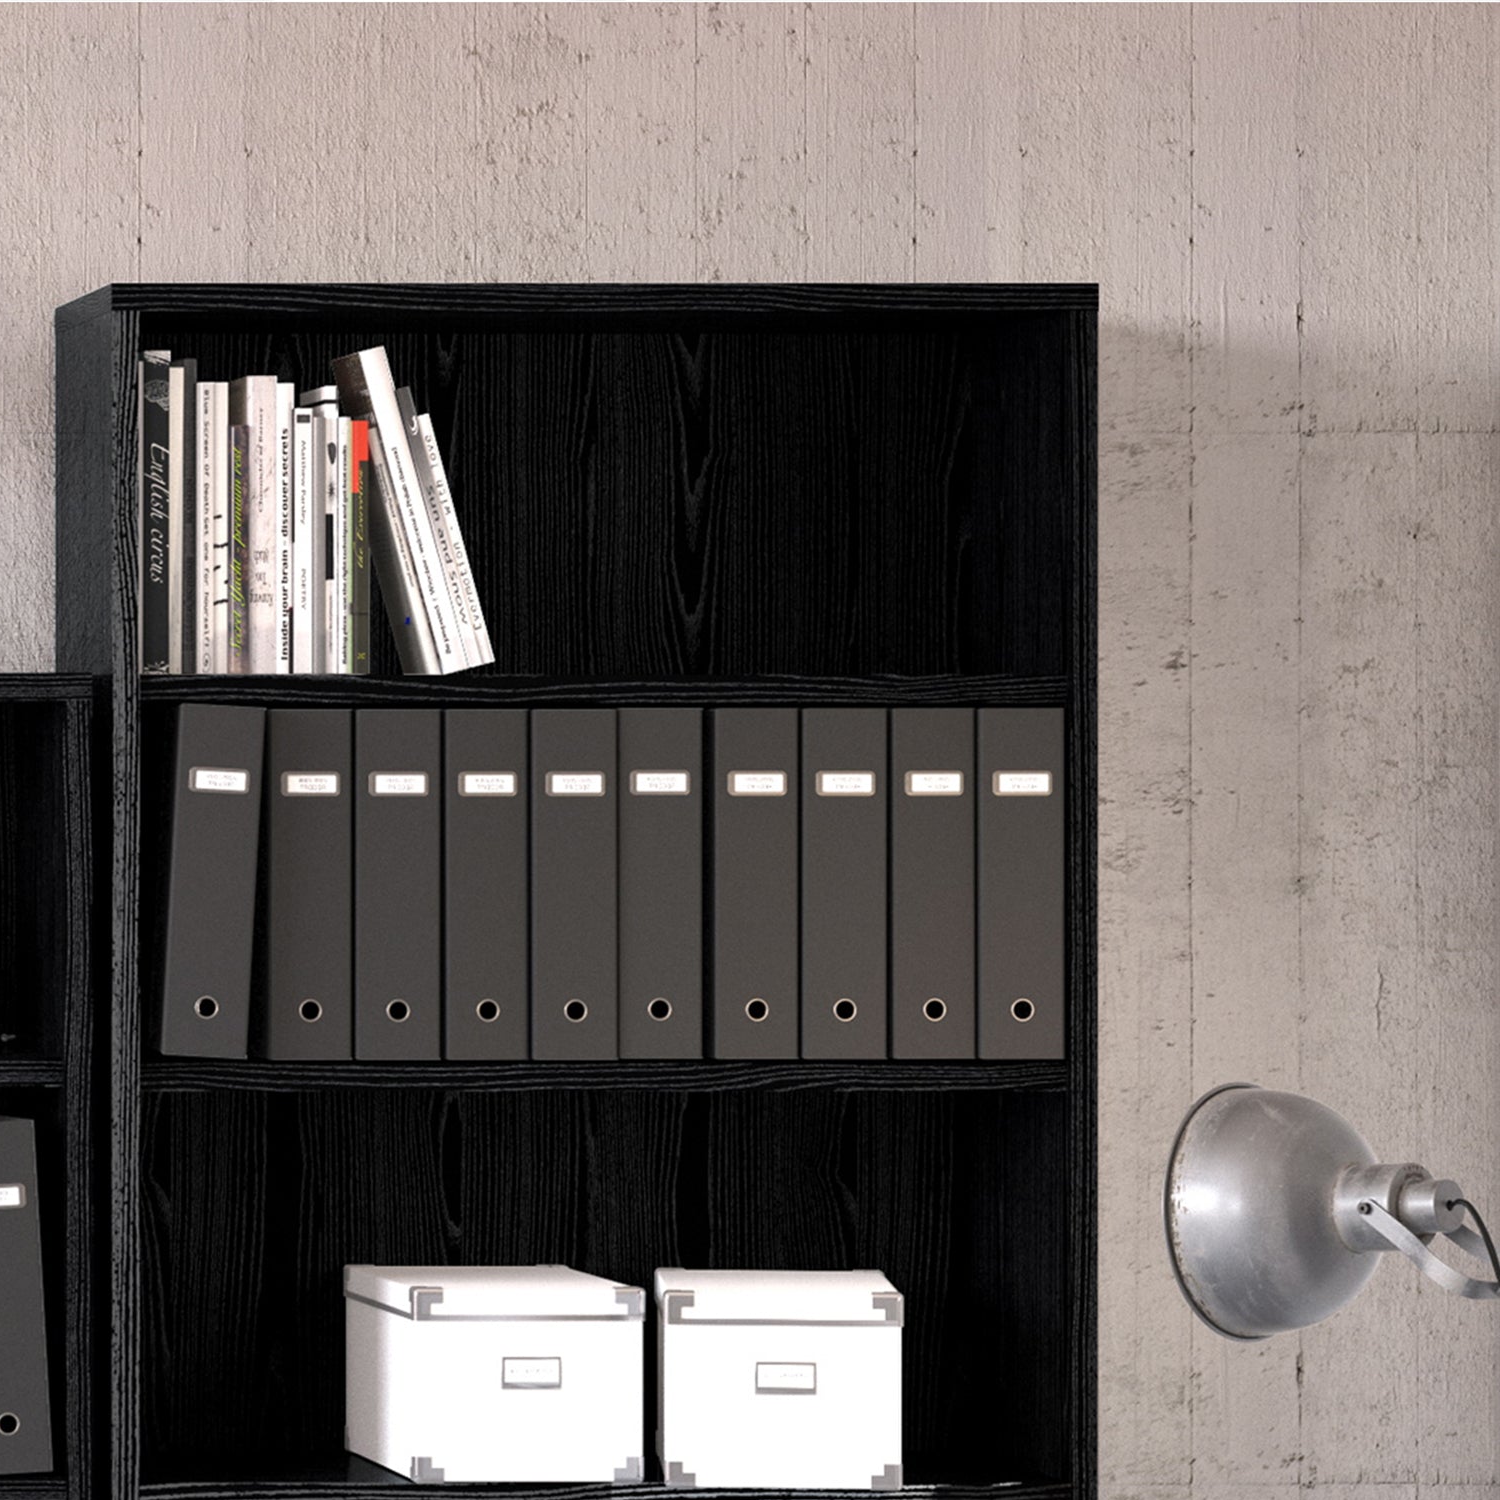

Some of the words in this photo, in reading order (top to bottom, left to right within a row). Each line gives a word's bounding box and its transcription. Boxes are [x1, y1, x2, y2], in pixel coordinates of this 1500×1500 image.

[425, 434, 439, 468] love
[144, 443, 170, 519] English
[436, 480, 451, 515] with
[149, 528, 170, 584] circus
[281, 586, 290, 617] your
[453, 541, 482, 631] Evermotion
